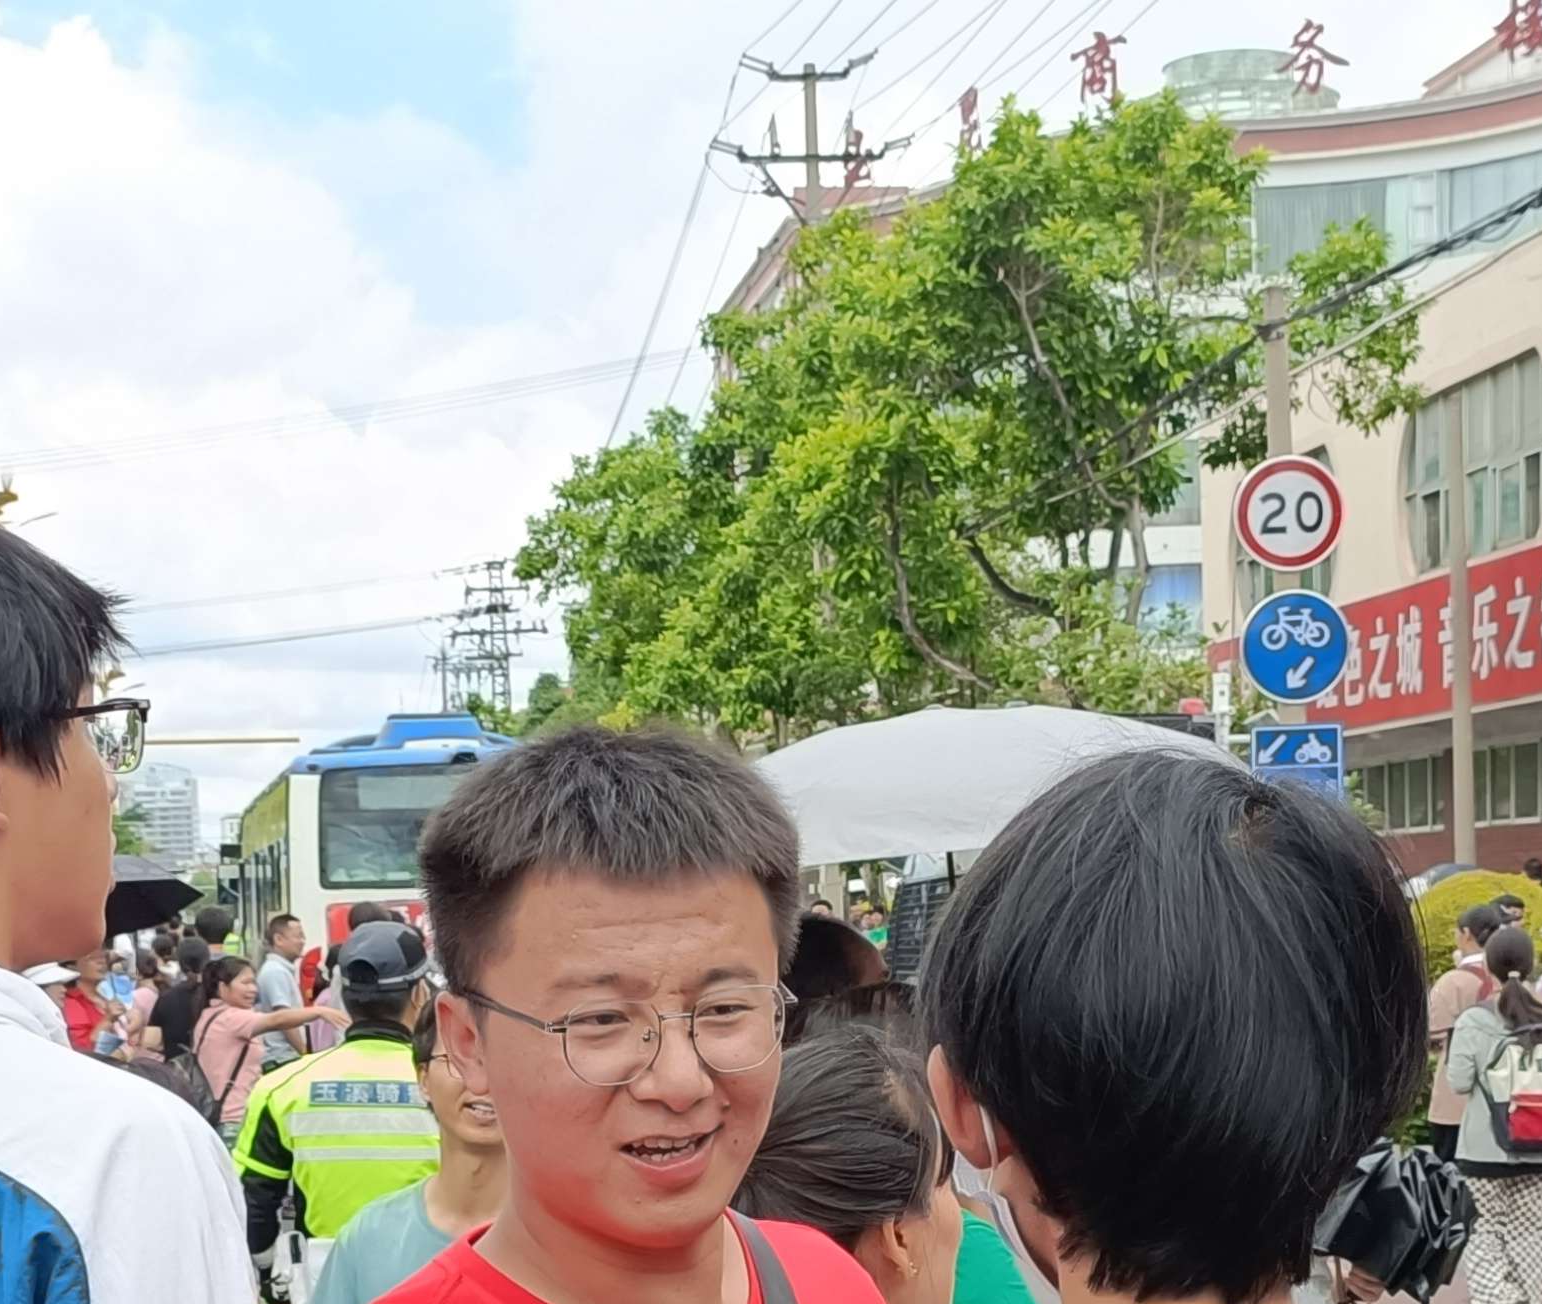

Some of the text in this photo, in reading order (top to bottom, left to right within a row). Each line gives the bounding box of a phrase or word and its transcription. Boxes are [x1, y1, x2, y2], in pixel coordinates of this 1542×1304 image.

[1260, 491, 1323, 534] 20
[1316, 605, 1422, 708] 色之城
